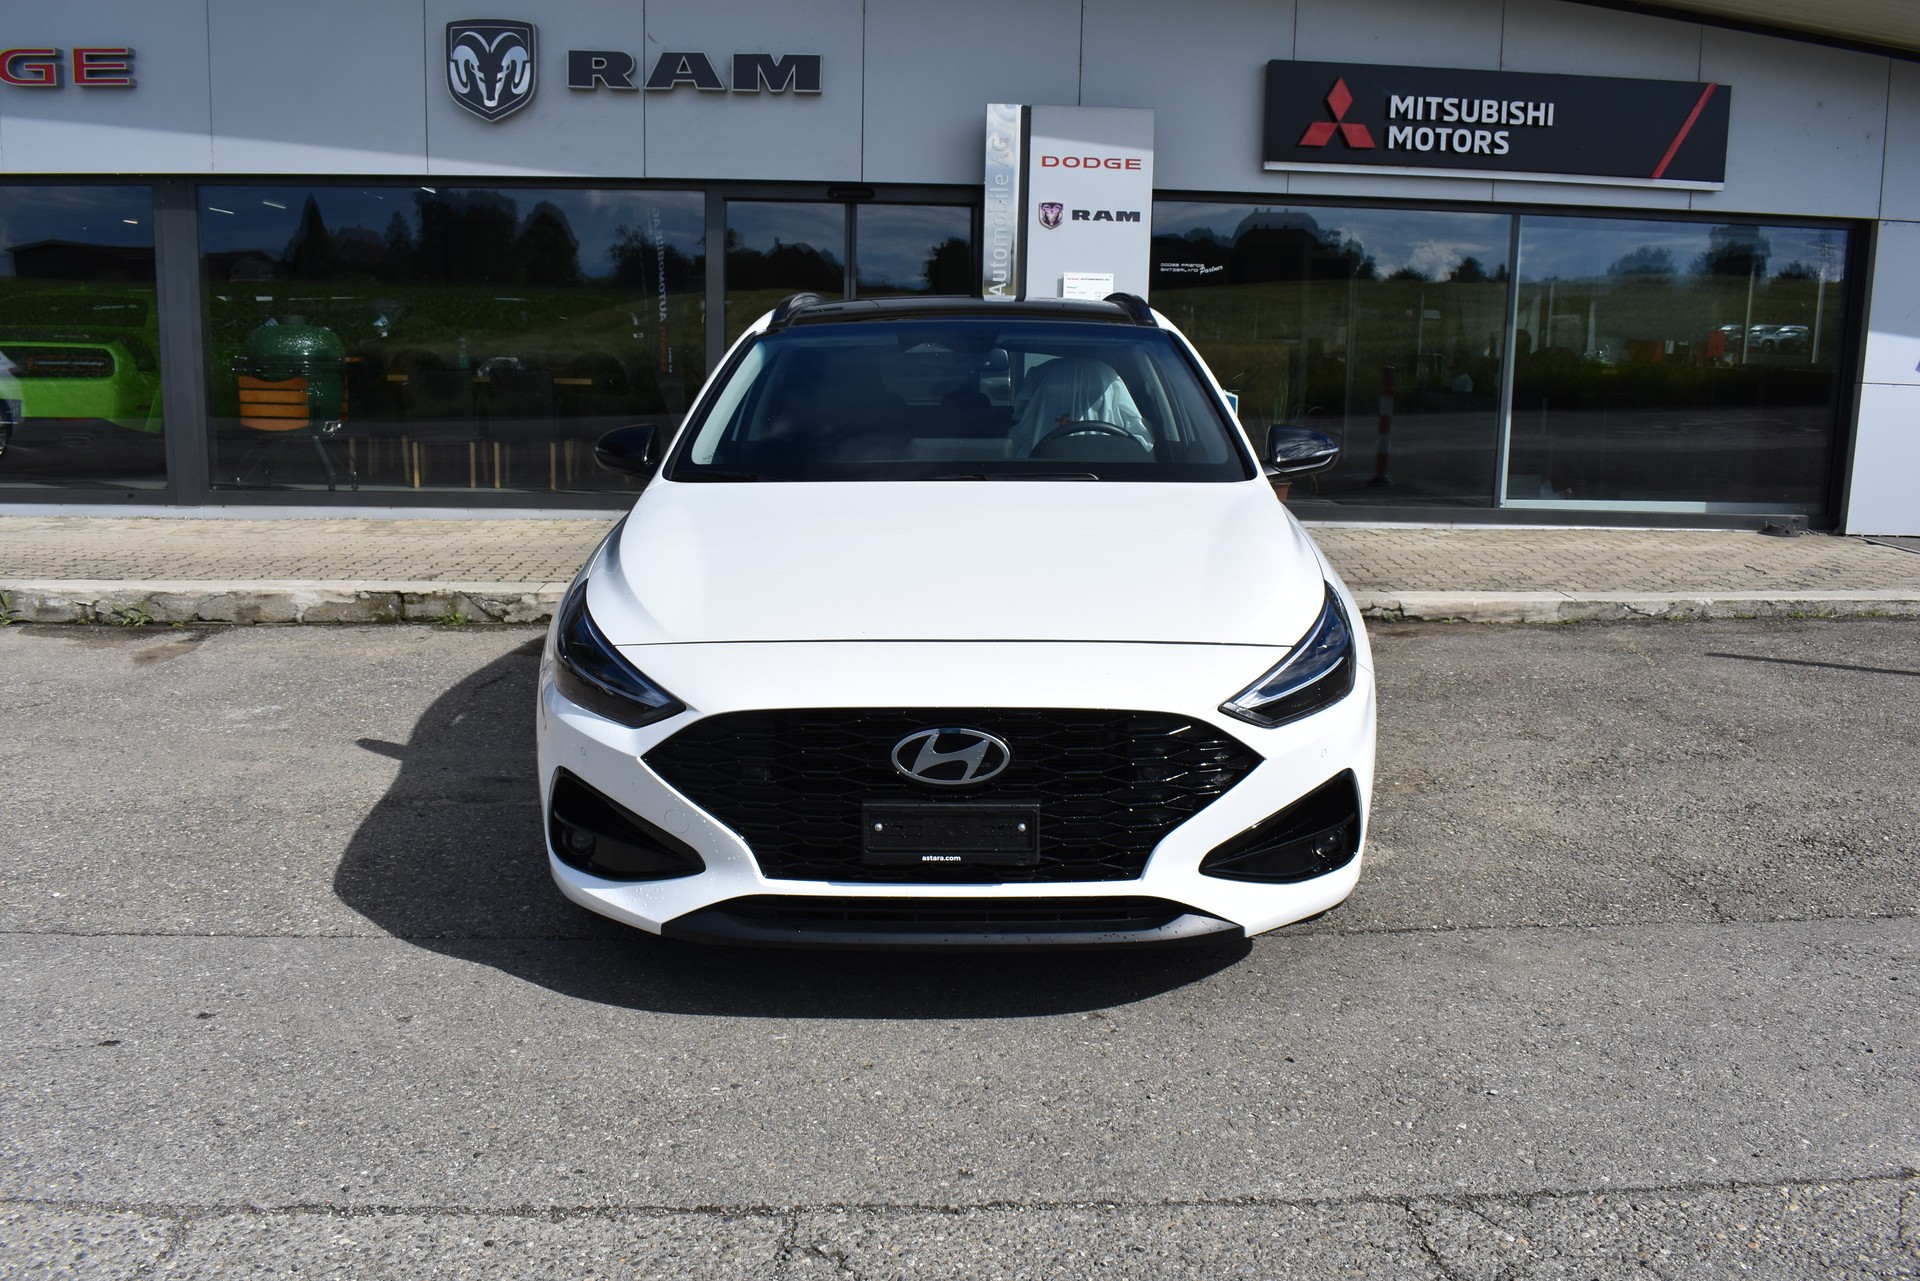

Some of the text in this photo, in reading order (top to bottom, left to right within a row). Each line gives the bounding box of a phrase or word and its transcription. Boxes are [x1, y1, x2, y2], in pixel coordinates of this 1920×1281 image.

[0, 47, 133, 87] GE
[567, 49, 823, 93] RAM
[1389, 94, 1555, 127] MITSUBISHI
[1388, 125, 1510, 155] MOTORS
[1041, 155, 1142, 171] DODGE
[988, 134, 1009, 297] Automobile AG
[1071, 209, 1141, 223] RAM
